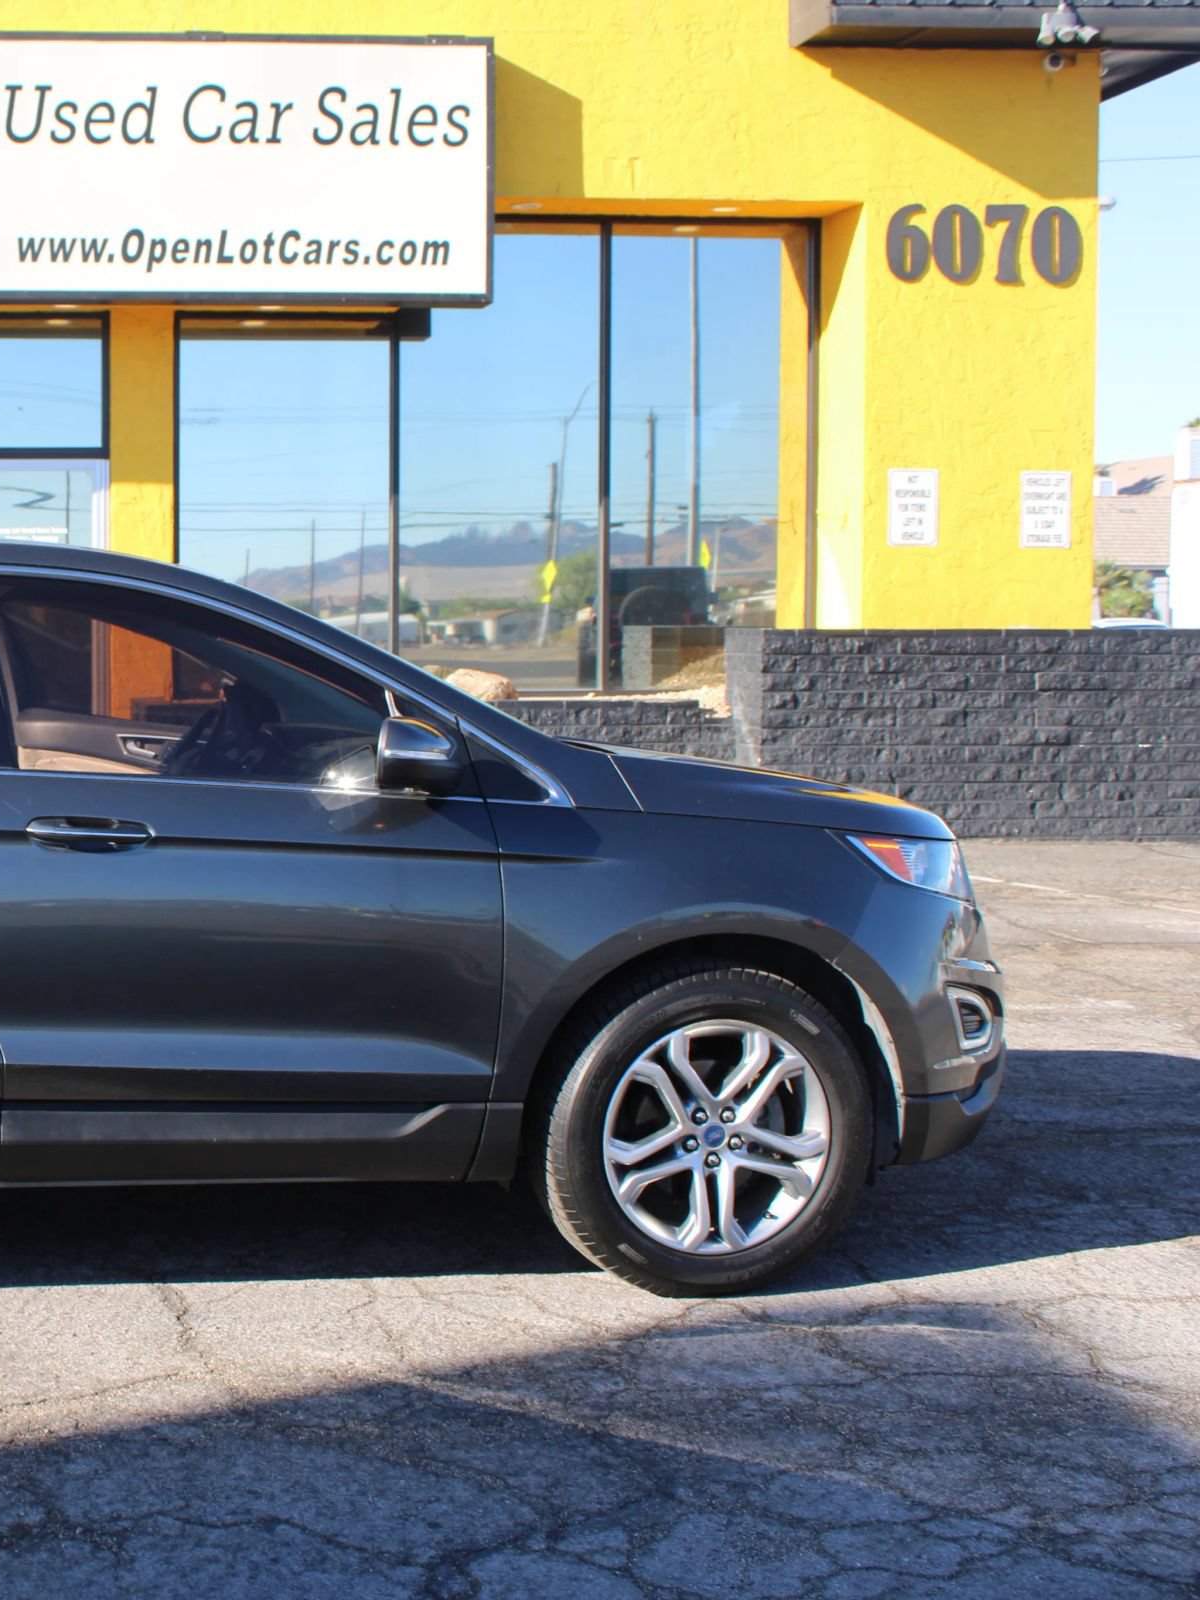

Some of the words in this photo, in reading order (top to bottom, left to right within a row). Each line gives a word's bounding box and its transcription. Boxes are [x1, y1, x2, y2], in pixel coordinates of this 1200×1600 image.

[5, 84, 159, 145] Used
[183, 84, 294, 145] Car
[311, 86, 471, 147] Sales
[17, 228, 450, 273] www.OpenLotCars.com
[886, 203, 1084, 288] 6070
